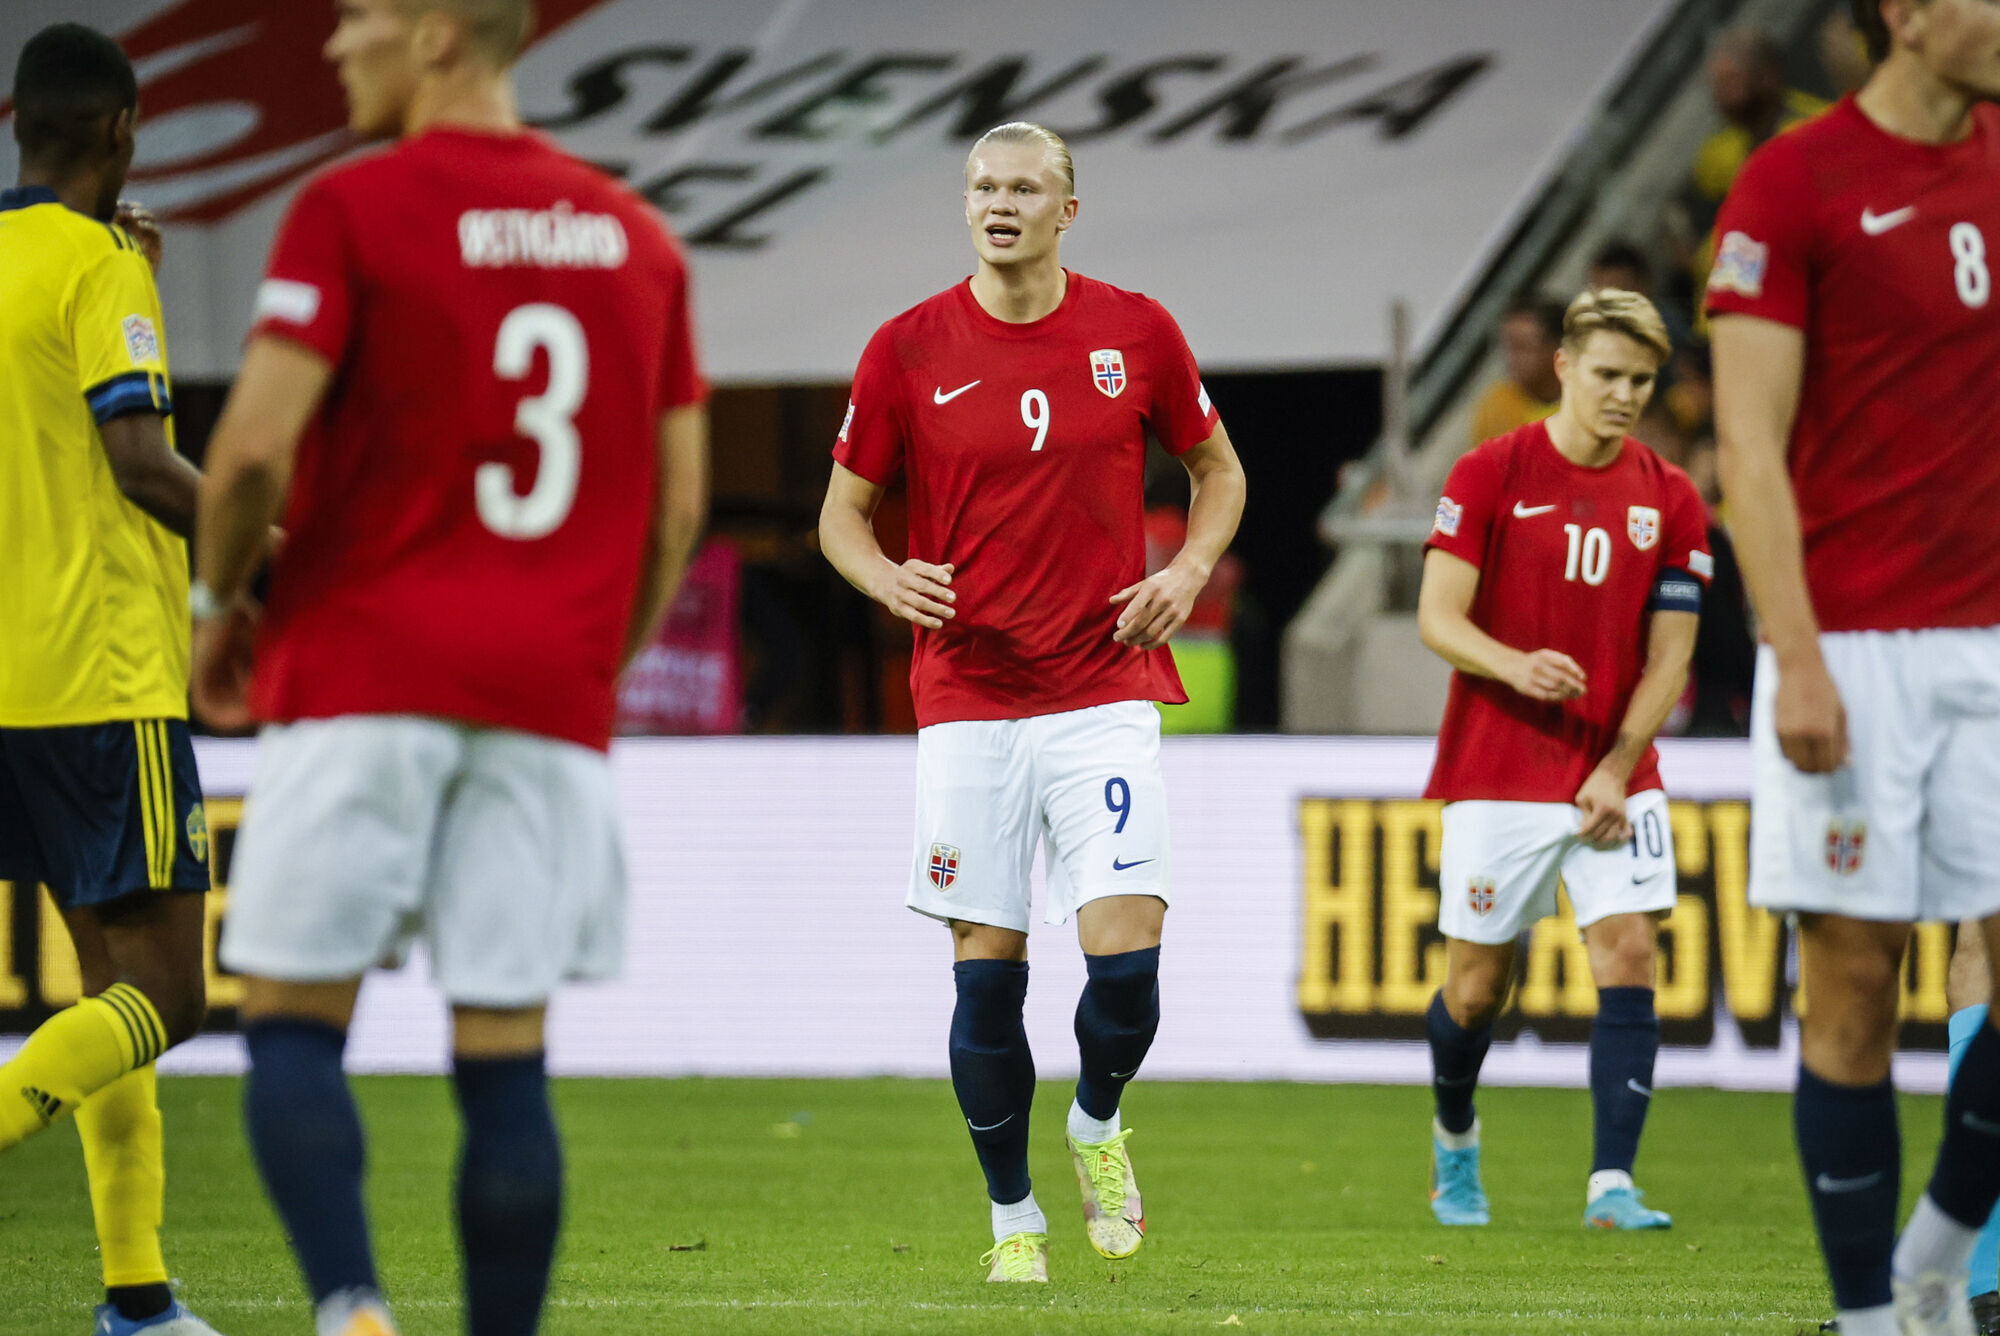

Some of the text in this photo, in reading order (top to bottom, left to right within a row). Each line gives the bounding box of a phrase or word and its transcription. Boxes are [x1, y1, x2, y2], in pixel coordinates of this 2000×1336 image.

[518, 43, 1497, 143] SVENSKA
[590, 158, 840, 253] EL
[1949, 221, 1992, 310] 8
[474, 302, 590, 541] 3
[1020, 388, 1051, 452] 9
[1563, 523, 1612, 587] 10
[1104, 776, 1131, 834] 9
